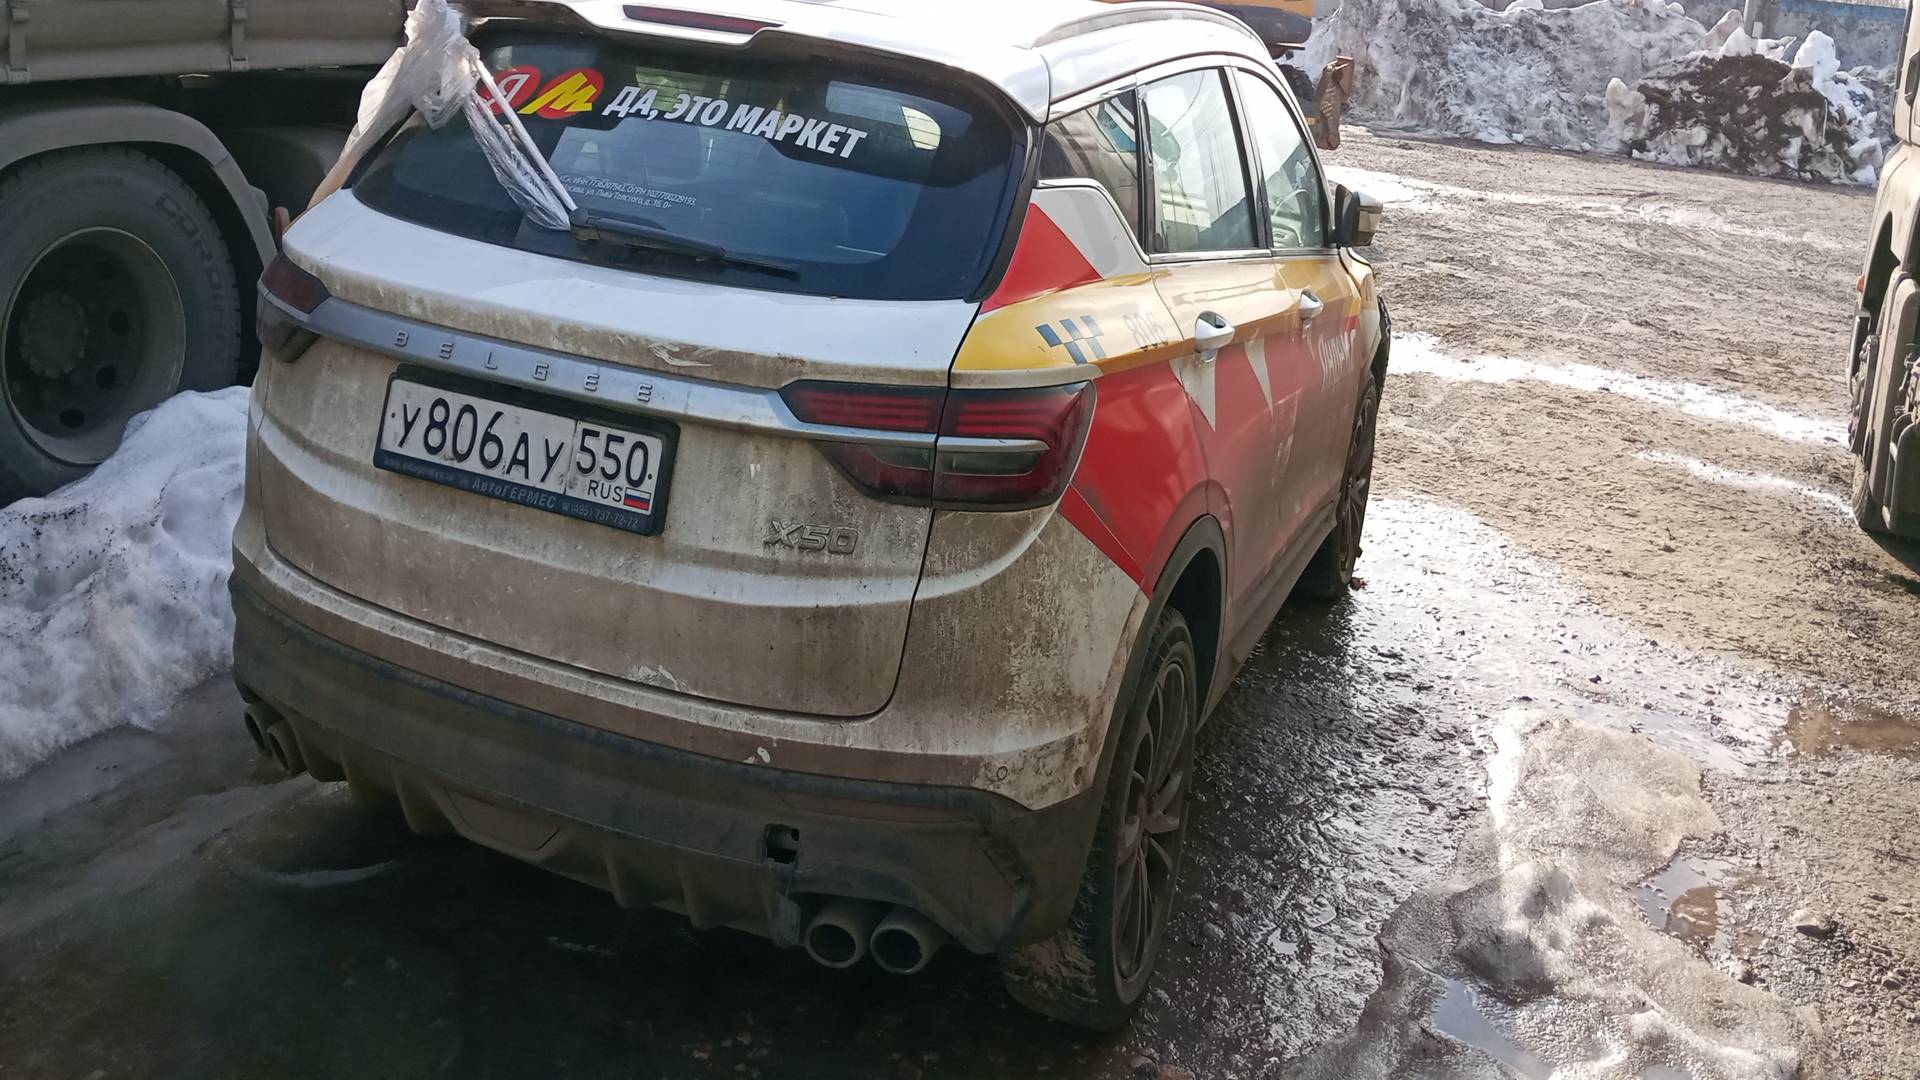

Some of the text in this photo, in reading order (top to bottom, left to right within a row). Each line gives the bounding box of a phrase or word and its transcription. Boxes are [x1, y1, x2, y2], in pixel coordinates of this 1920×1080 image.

[602, 85, 868, 159] ДА, ЭТО МАРКЕТ
[1122, 311, 1169, 353] 806
[394, 329, 654, 403] BELGEE
[575, 427, 650, 489] 550
[587, 479, 623, 503] RUS
[569, 503, 594, 518] (495)
[595, 507, 641, 529] 737-72-72
[763, 520, 859, 555] X50
